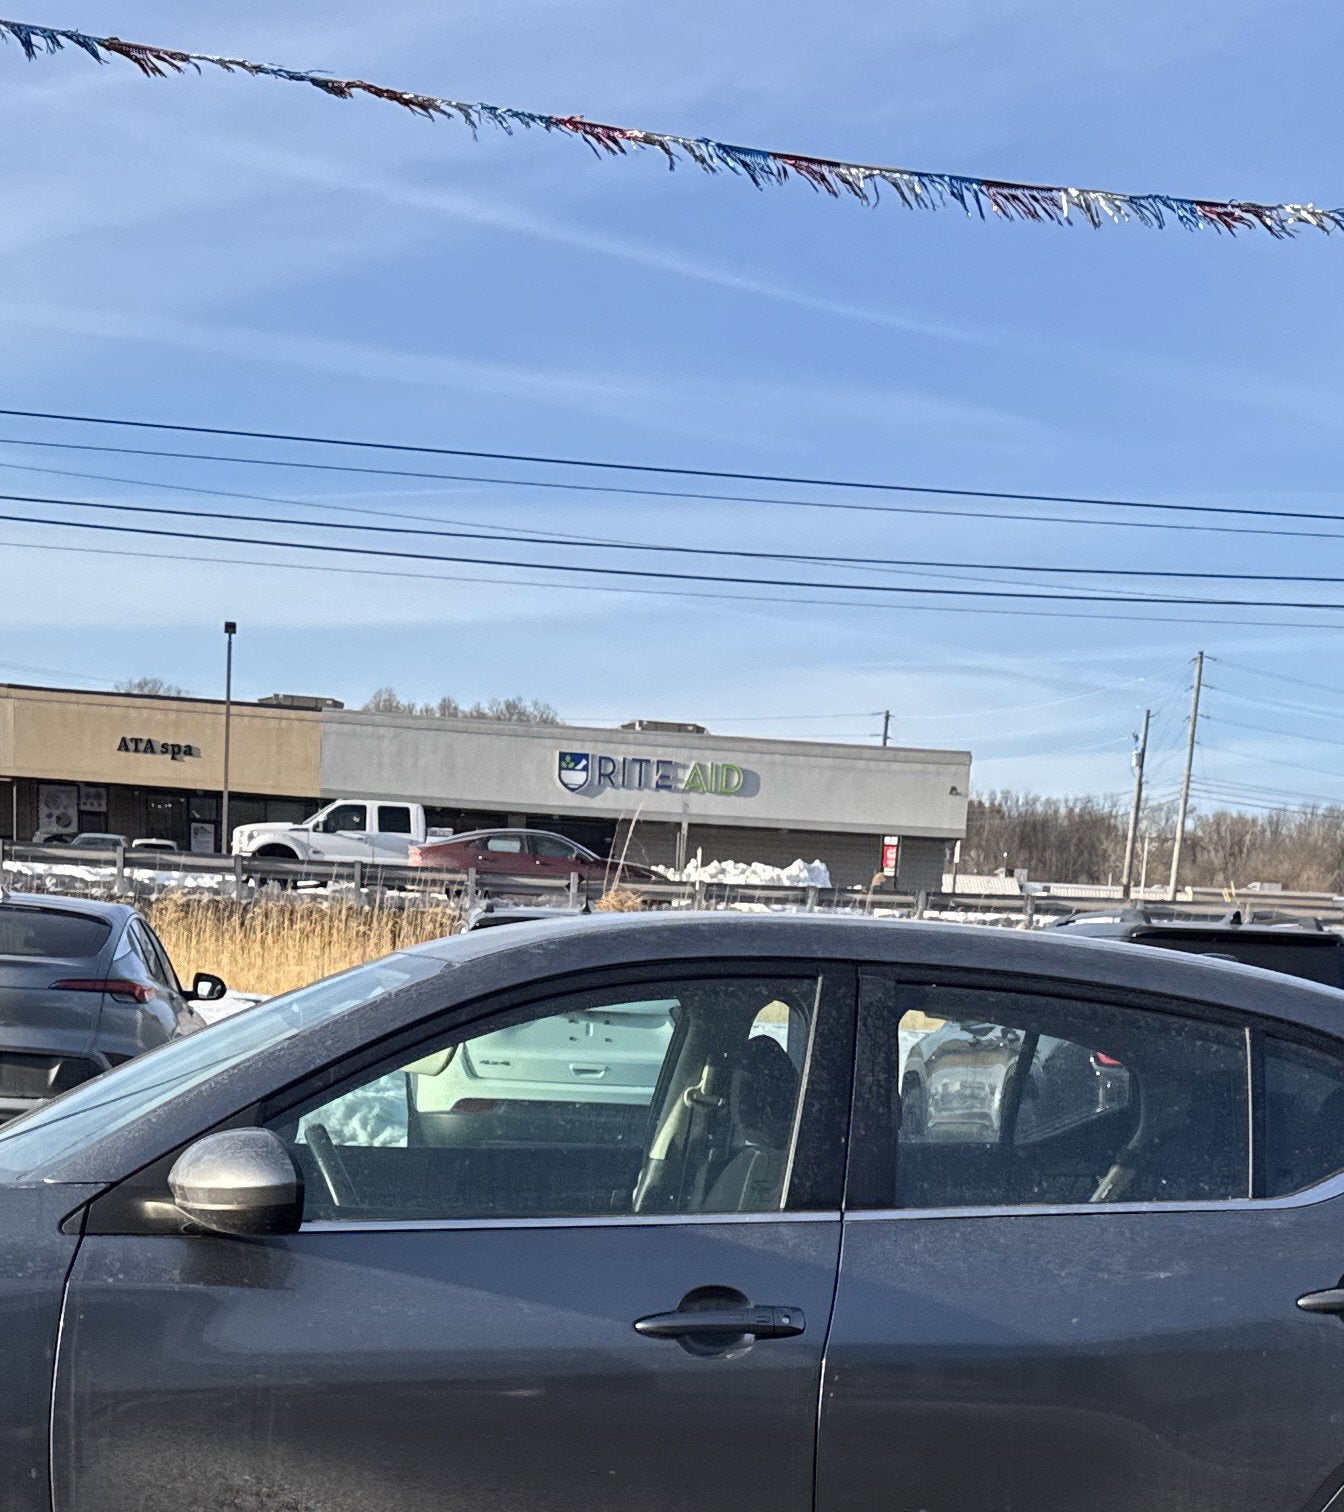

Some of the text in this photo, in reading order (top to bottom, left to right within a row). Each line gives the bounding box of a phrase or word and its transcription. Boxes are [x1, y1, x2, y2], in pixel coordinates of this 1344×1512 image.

[116, 736, 193, 761] ATA spa
[598, 755, 744, 795] RITE AID
